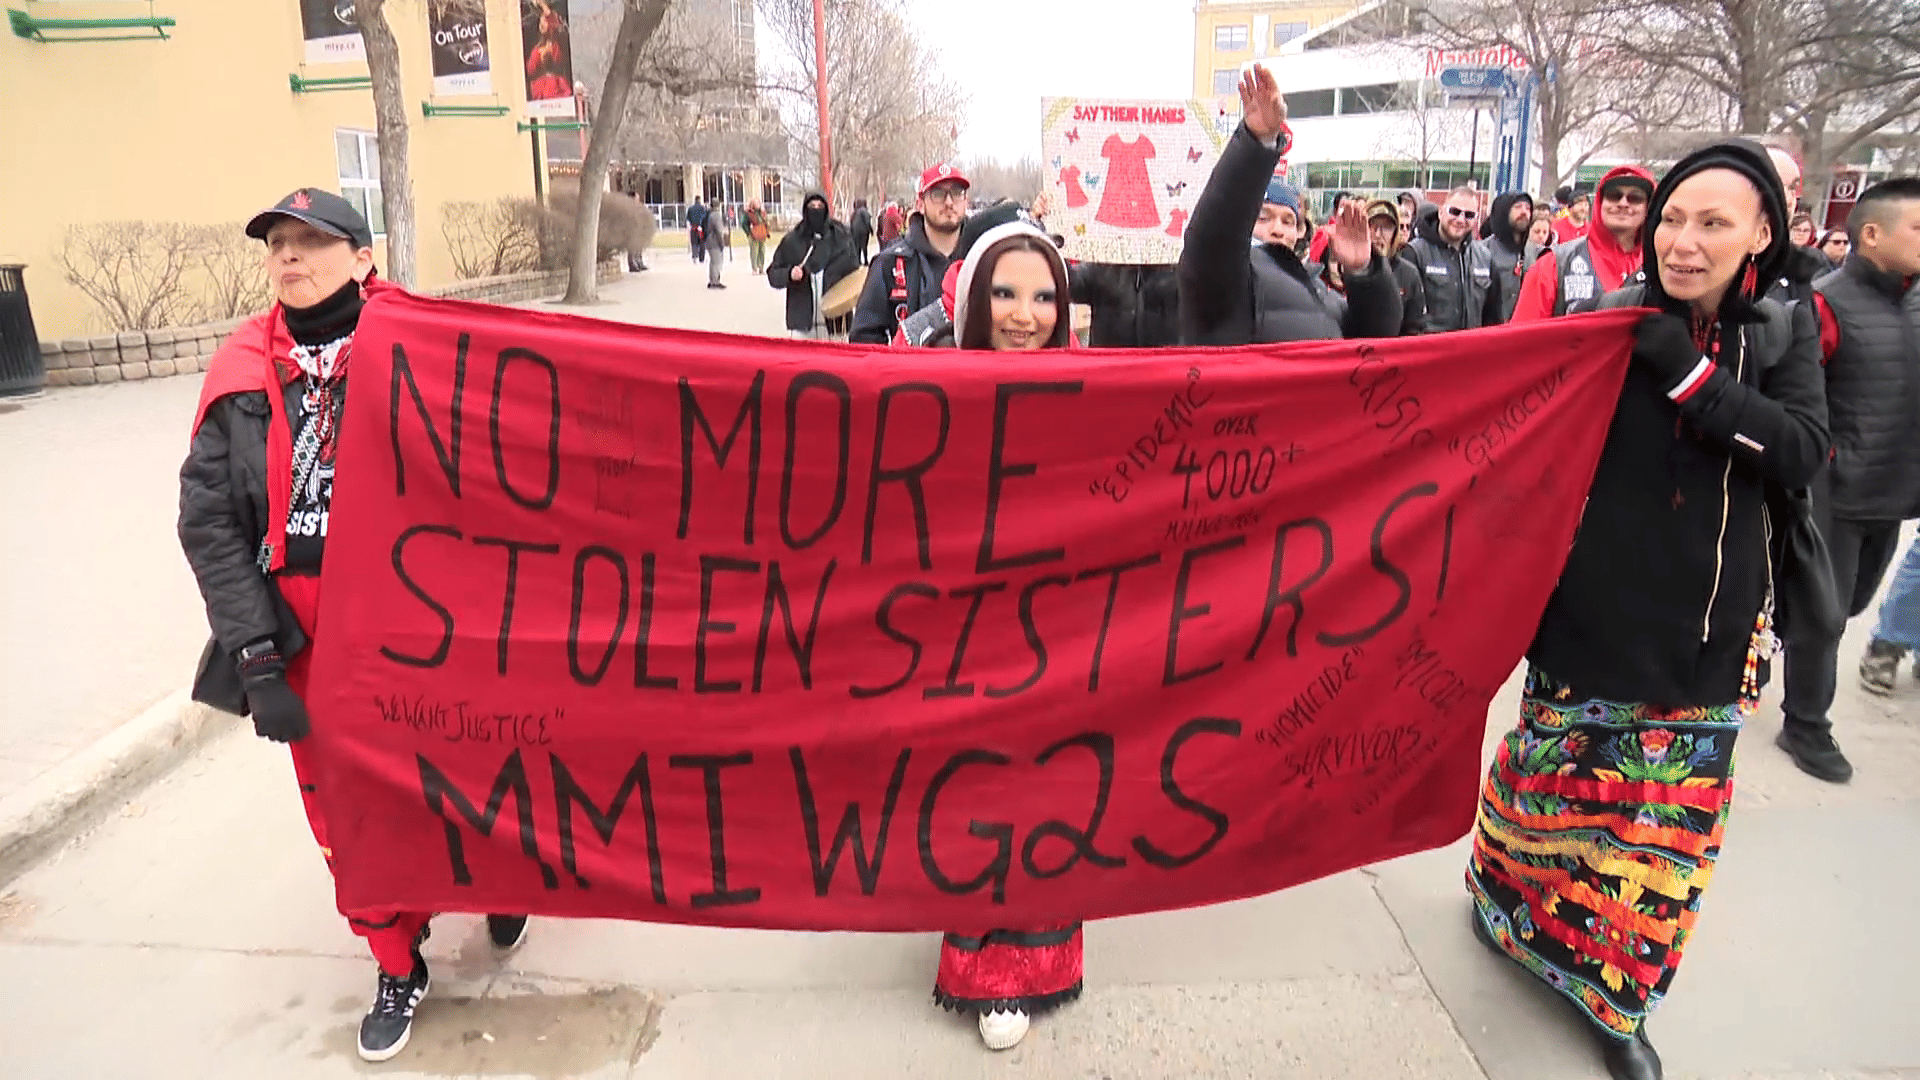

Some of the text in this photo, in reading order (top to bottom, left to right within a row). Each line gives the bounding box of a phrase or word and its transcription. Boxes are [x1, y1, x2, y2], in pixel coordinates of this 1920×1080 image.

[435, 22, 483, 46] On Tour
[1073, 105, 1099, 121] SAY
[1100, 106, 1139, 122] THEIR
[389, 332, 1084, 574] NO MORE
[379, 475, 1477, 699] STOLEN SISTERS!
[415, 717, 1242, 908] MMIWG2S
